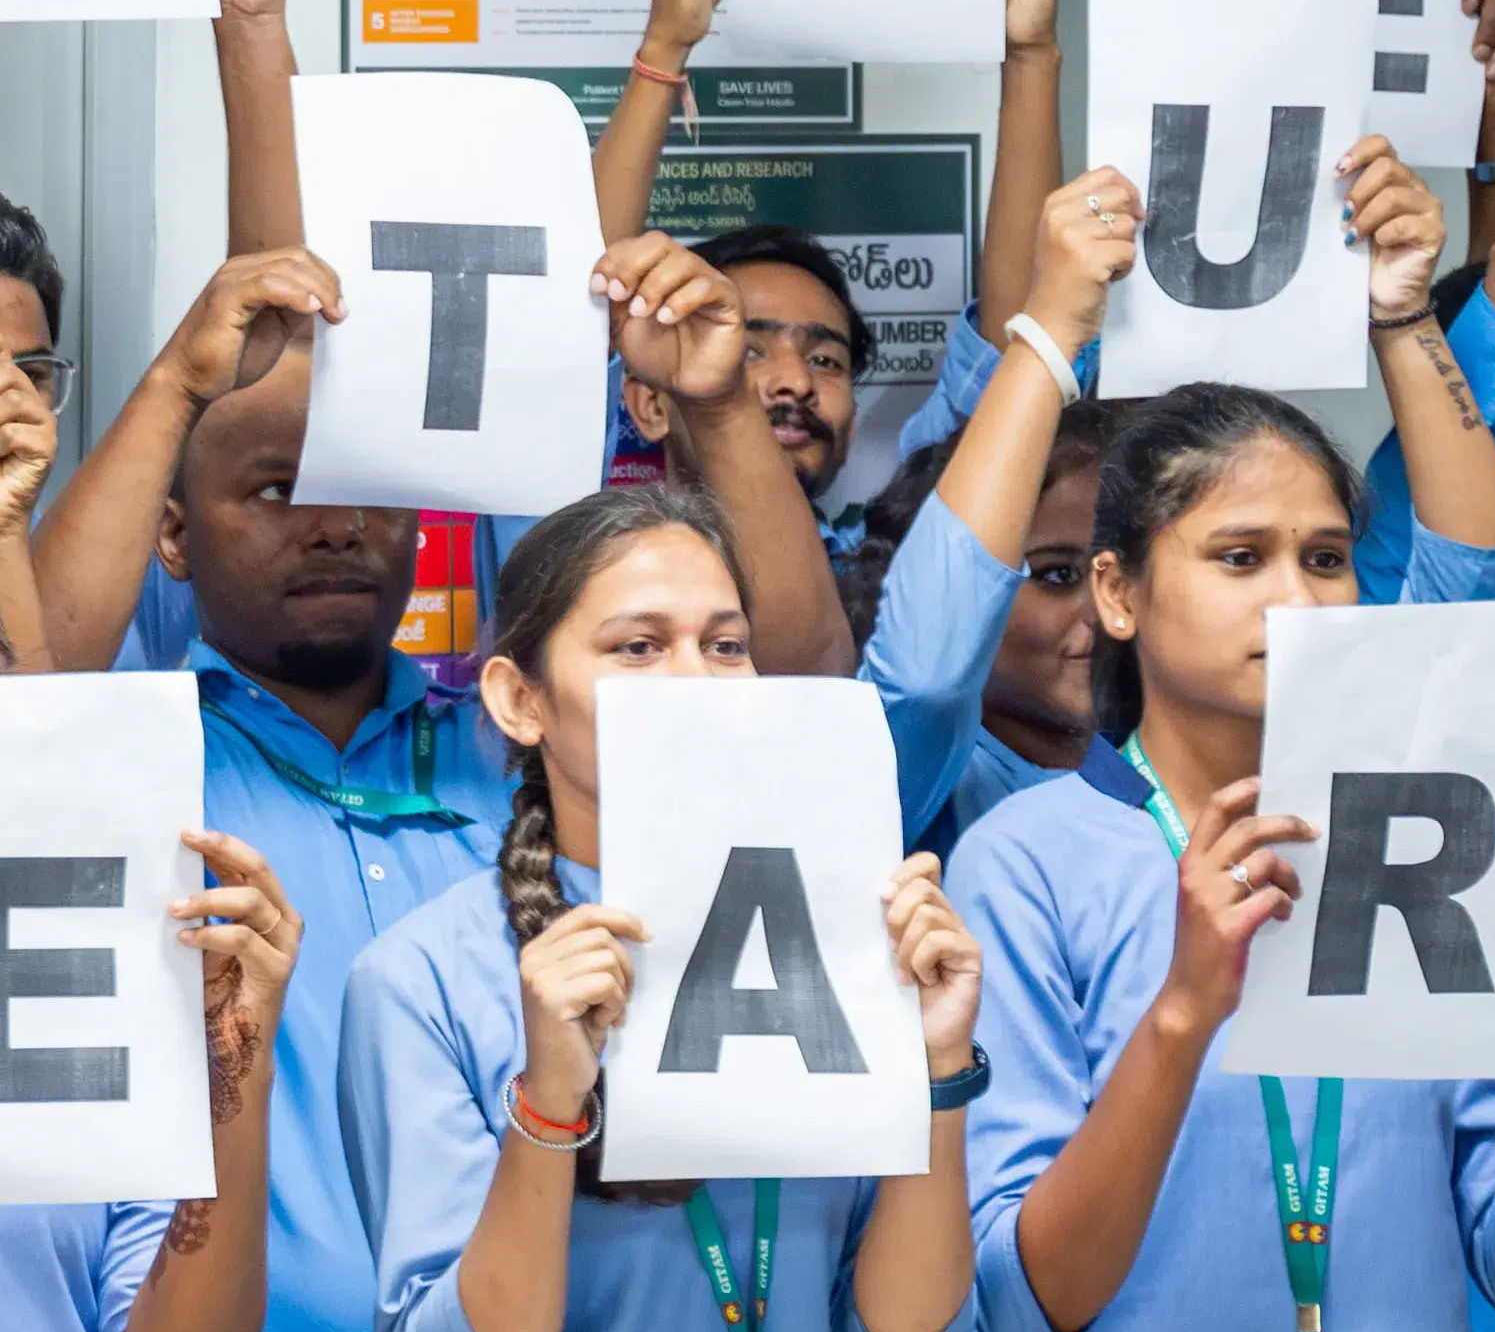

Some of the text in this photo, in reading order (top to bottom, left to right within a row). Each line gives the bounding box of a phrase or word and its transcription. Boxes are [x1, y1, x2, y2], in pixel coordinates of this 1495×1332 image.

[370, 12, 385, 30] 5
[656, 161, 814, 179] NCES AND RESEARCH
[1150, 104, 1326, 311] U
[370, 221, 548, 432] T
[610, 464, 658, 480] uction
[657, 847, 869, 1074] A
[1282, 1162, 1302, 1214] GITAM
[1314, 1166, 1331, 1216] GITAM
[708, 1244, 733, 1294] GITAM
[759, 1238, 770, 1289] GITAM
